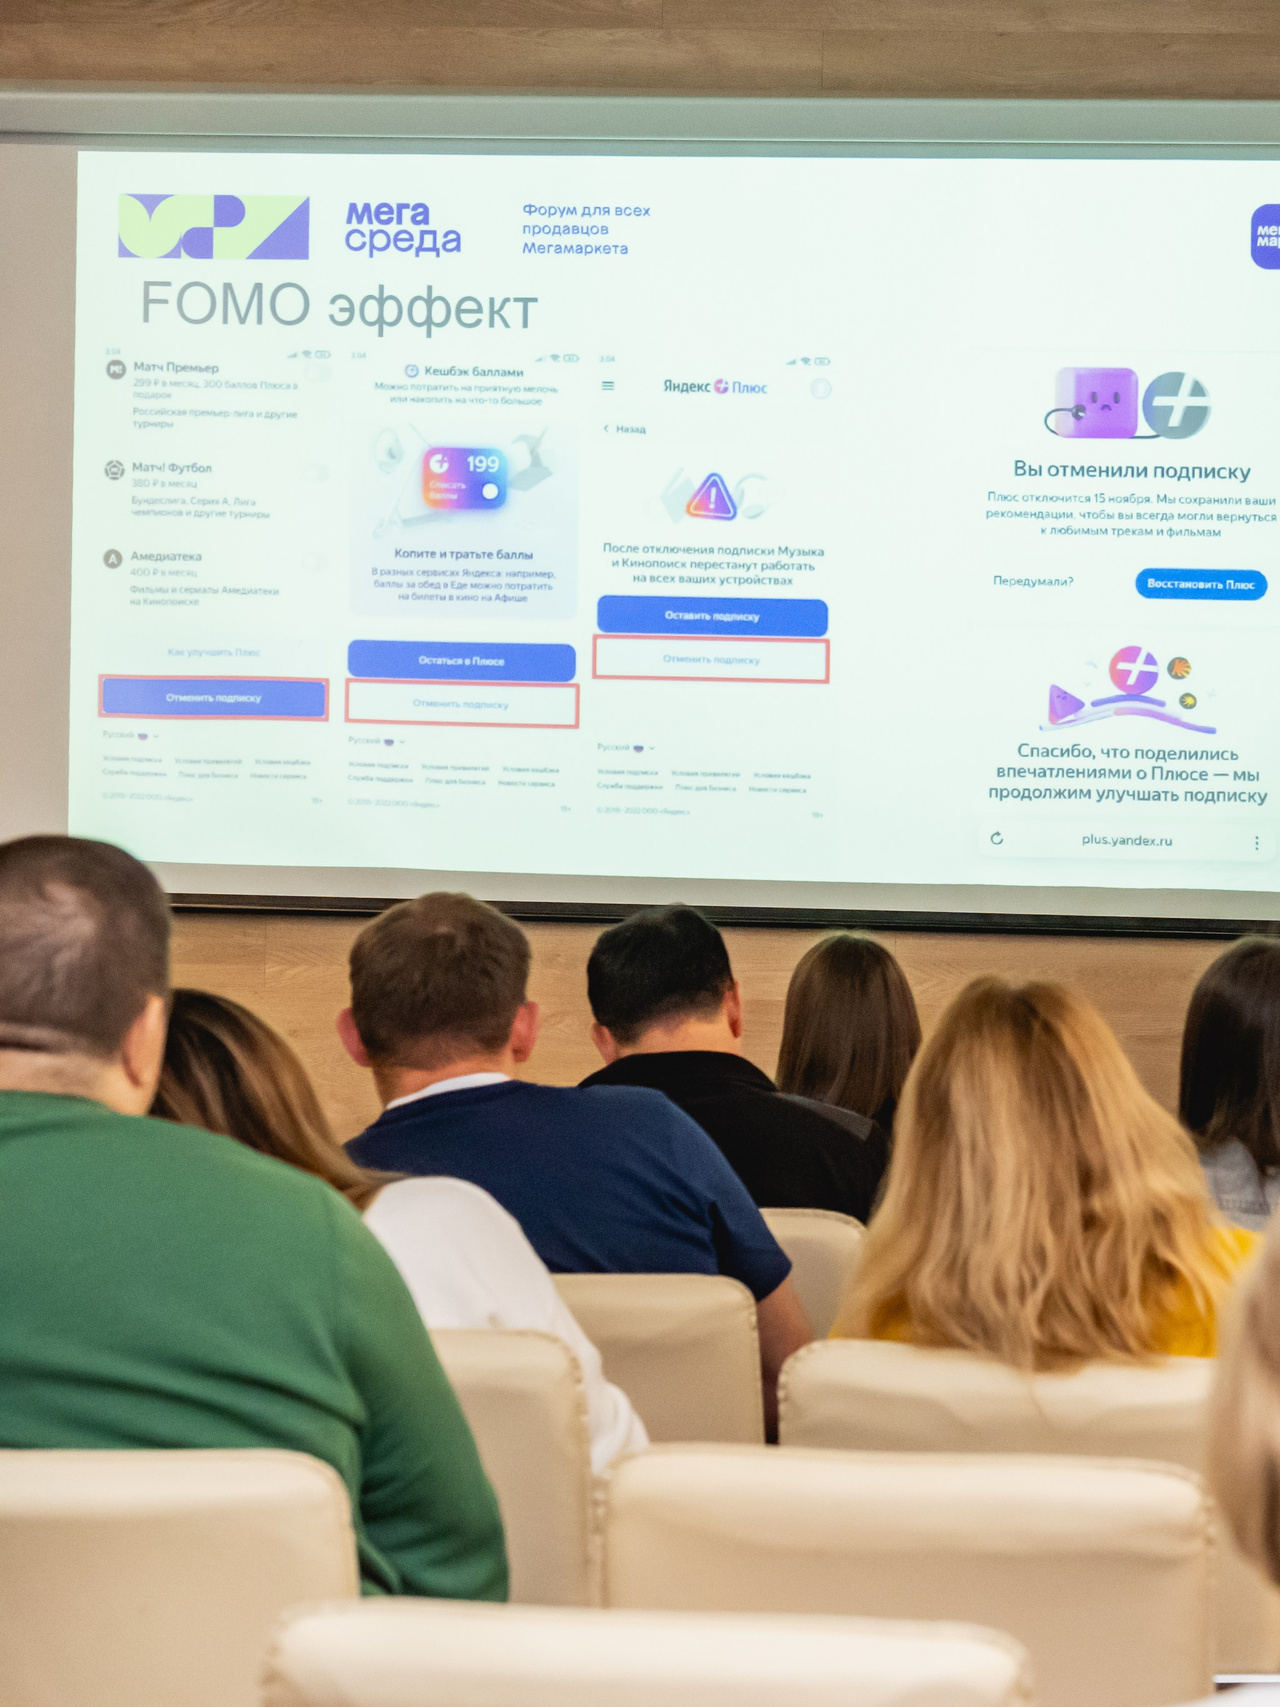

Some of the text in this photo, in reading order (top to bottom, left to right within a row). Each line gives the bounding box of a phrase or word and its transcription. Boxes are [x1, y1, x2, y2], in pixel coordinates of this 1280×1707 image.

[346, 202, 430, 226] мега
[523, 203, 651, 218] Форум для всех
[523, 224, 609, 237] продавцов
[345, 228, 461, 259] среда
[522, 242, 628, 256] Мегамаркета
[142, 280, 539, 339] FOMO эффект
[133, 361, 219, 375] Матч Премьер
[424, 366, 524, 378] Кешбэк баллами
[374, 382, 408, 391] Можно
[410, 383, 459, 393] потратить
[474, 385, 521, 394] приятную
[524, 386, 558, 394] мелочь
[663, 379, 768, 394] Яндекс Плюс
[390, 396, 408, 404] или
[410, 396, 453, 405] накопить
[469, 397, 499, 405] что-то
[500, 396, 543, 405] большое
[132, 407, 187, 417] Российская
[264, 410, 298, 420] другие
[133, 420, 174, 430] турниры
[615, 425, 646, 435] Назад
[132, 462, 213, 475] Матч! Футбол
[467, 456, 499, 472] 199
[1014, 460, 1251, 483] Вы отменили подписку
[190, 497, 220, 507] Серия
[233, 498, 256, 507] Лига
[987, 492, 1276, 508] Плюс отключится 15 ноября. Мы сохранили ваши
[131, 508, 183, 517] чемпионов
[193, 510, 226, 519] другие
[229, 511, 270, 520] турниры
[986, 509, 1277, 525] рекомендации, чтобы вы всегда могли вернуться
[1050, 526, 1108, 537] любимым
[1111, 528, 1153, 539] трекам
[1166, 527, 1221, 539] фильмам
[130, 551, 202, 563] Амедиатека
[394, 549, 437, 560] Копите
[449, 551, 493, 562] тратьте
[496, 549, 533, 560] баллы
[603, 543, 825, 558] После отключения подписки Музыка
[621, 558, 687, 569] Кинопоиск
[690, 561, 757, 572] перестанут
[761, 560, 815, 572] работать
[379, 569, 414, 578] разных
[416, 570, 459, 579] сервисах
[633, 574, 794, 586] на всех ваших устройствах
[373, 579, 403, 589] баллы
[418, 580, 441, 591] обед
[450, 581, 468, 592] Еде
[504, 583, 553, 593] потратить
[993, 575, 1074, 588] Передумали?
[1147, 579, 1255, 591] Восстановить Плюс
[129, 585, 169, 595] Фильмы
[179, 587, 219, 597] сериалы
[221, 586, 280, 597] Амедиатеки
[398, 593, 410, 601] на
[411, 592, 446, 601] билеты
[494, 593, 528, 603] Афише
[664, 610, 760, 624] Оставить подписку
[418, 655, 463, 665] Остаться
[472, 656, 505, 667] Плюсе
[663, 654, 760, 667] Отменить подписку
[166, 693, 262, 705] Отменить подписку
[413, 699, 509, 711] Отменить подписку
[1017, 743, 1239, 762] Спасибо, что поделились
[996, 766, 1260, 782] впечатлениями о Плюсе мы
[988, 787, 1268, 806] продолжим улучшать подписку
[1082, 833, 1173, 847] plus.yandex.ru
